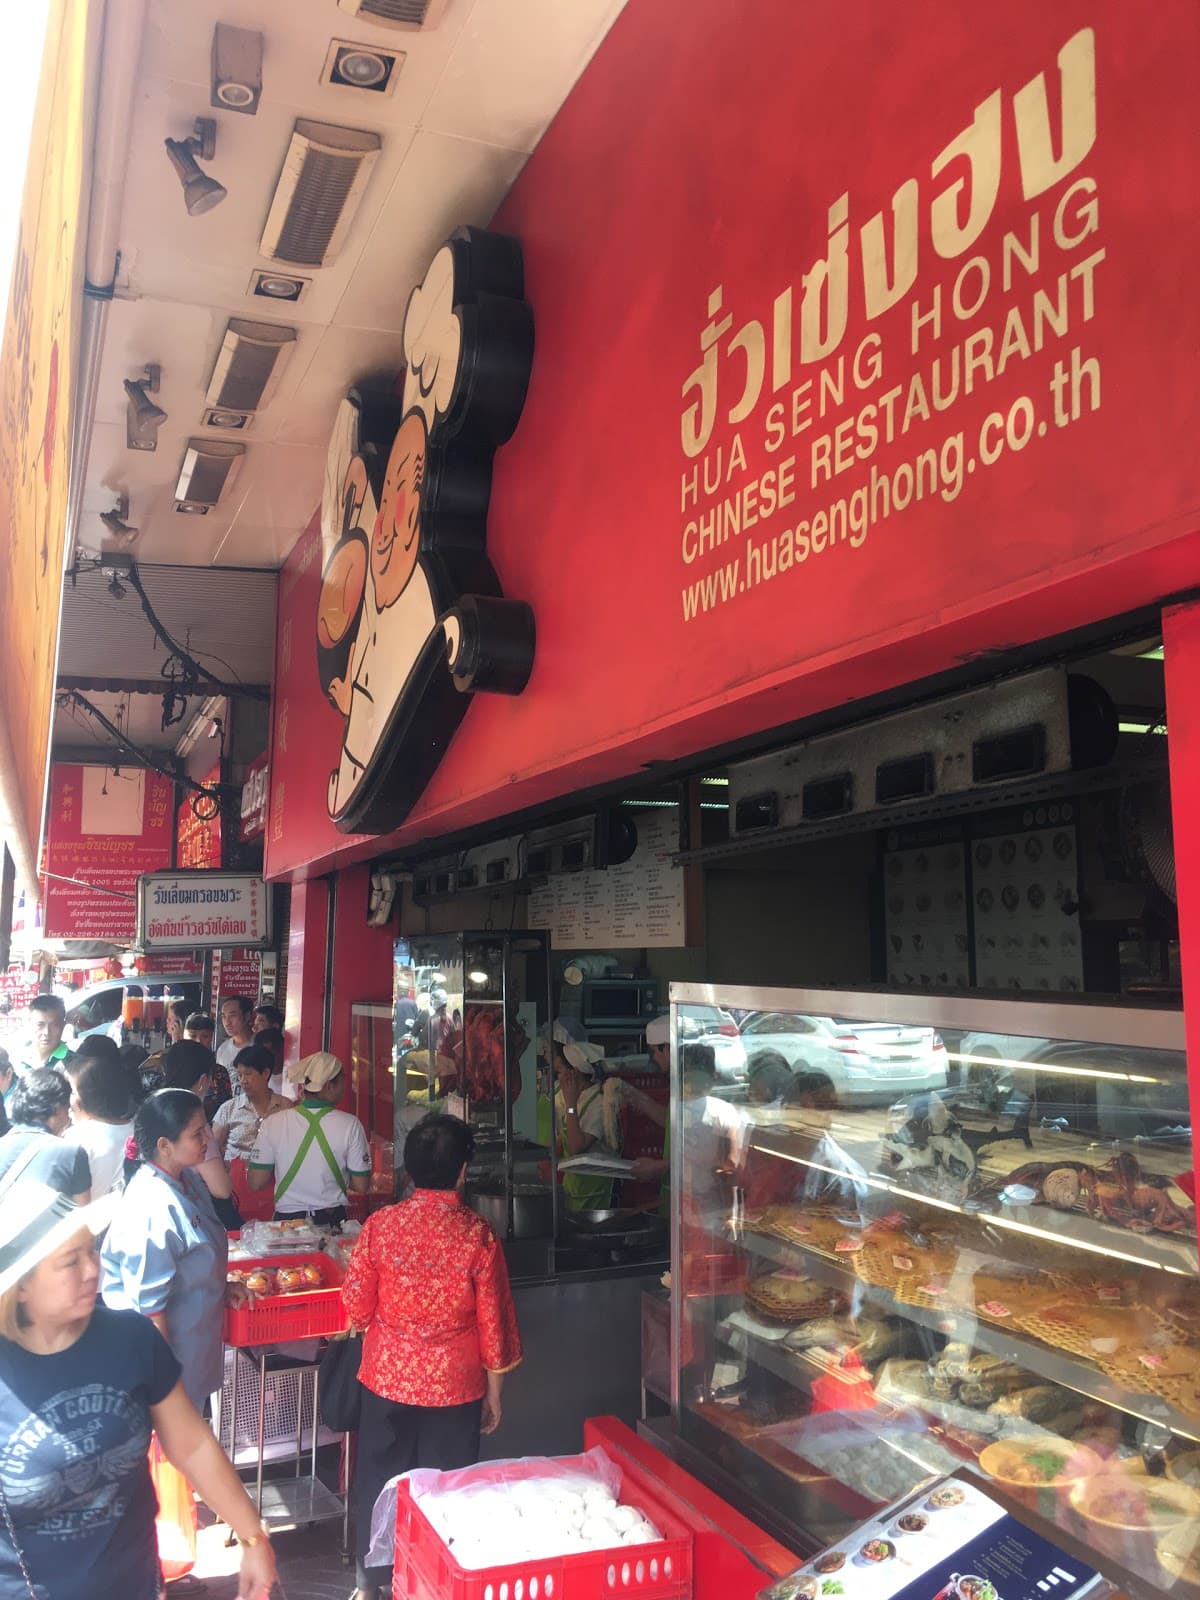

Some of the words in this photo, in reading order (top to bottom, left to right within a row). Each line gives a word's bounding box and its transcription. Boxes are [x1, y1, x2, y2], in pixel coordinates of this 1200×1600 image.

[681, 27, 1097, 458] ฮั่วเซ่งฮง
[681, 434, 748, 513] HUA
[764, 333, 883, 453] SENG
[911, 177, 1099, 352] HONG
[681, 456, 795, 564] CHINESE
[811, 248, 1106, 490] RESTAURANT
[681, 352, 1100, 622] www.huasenghong.co.th
